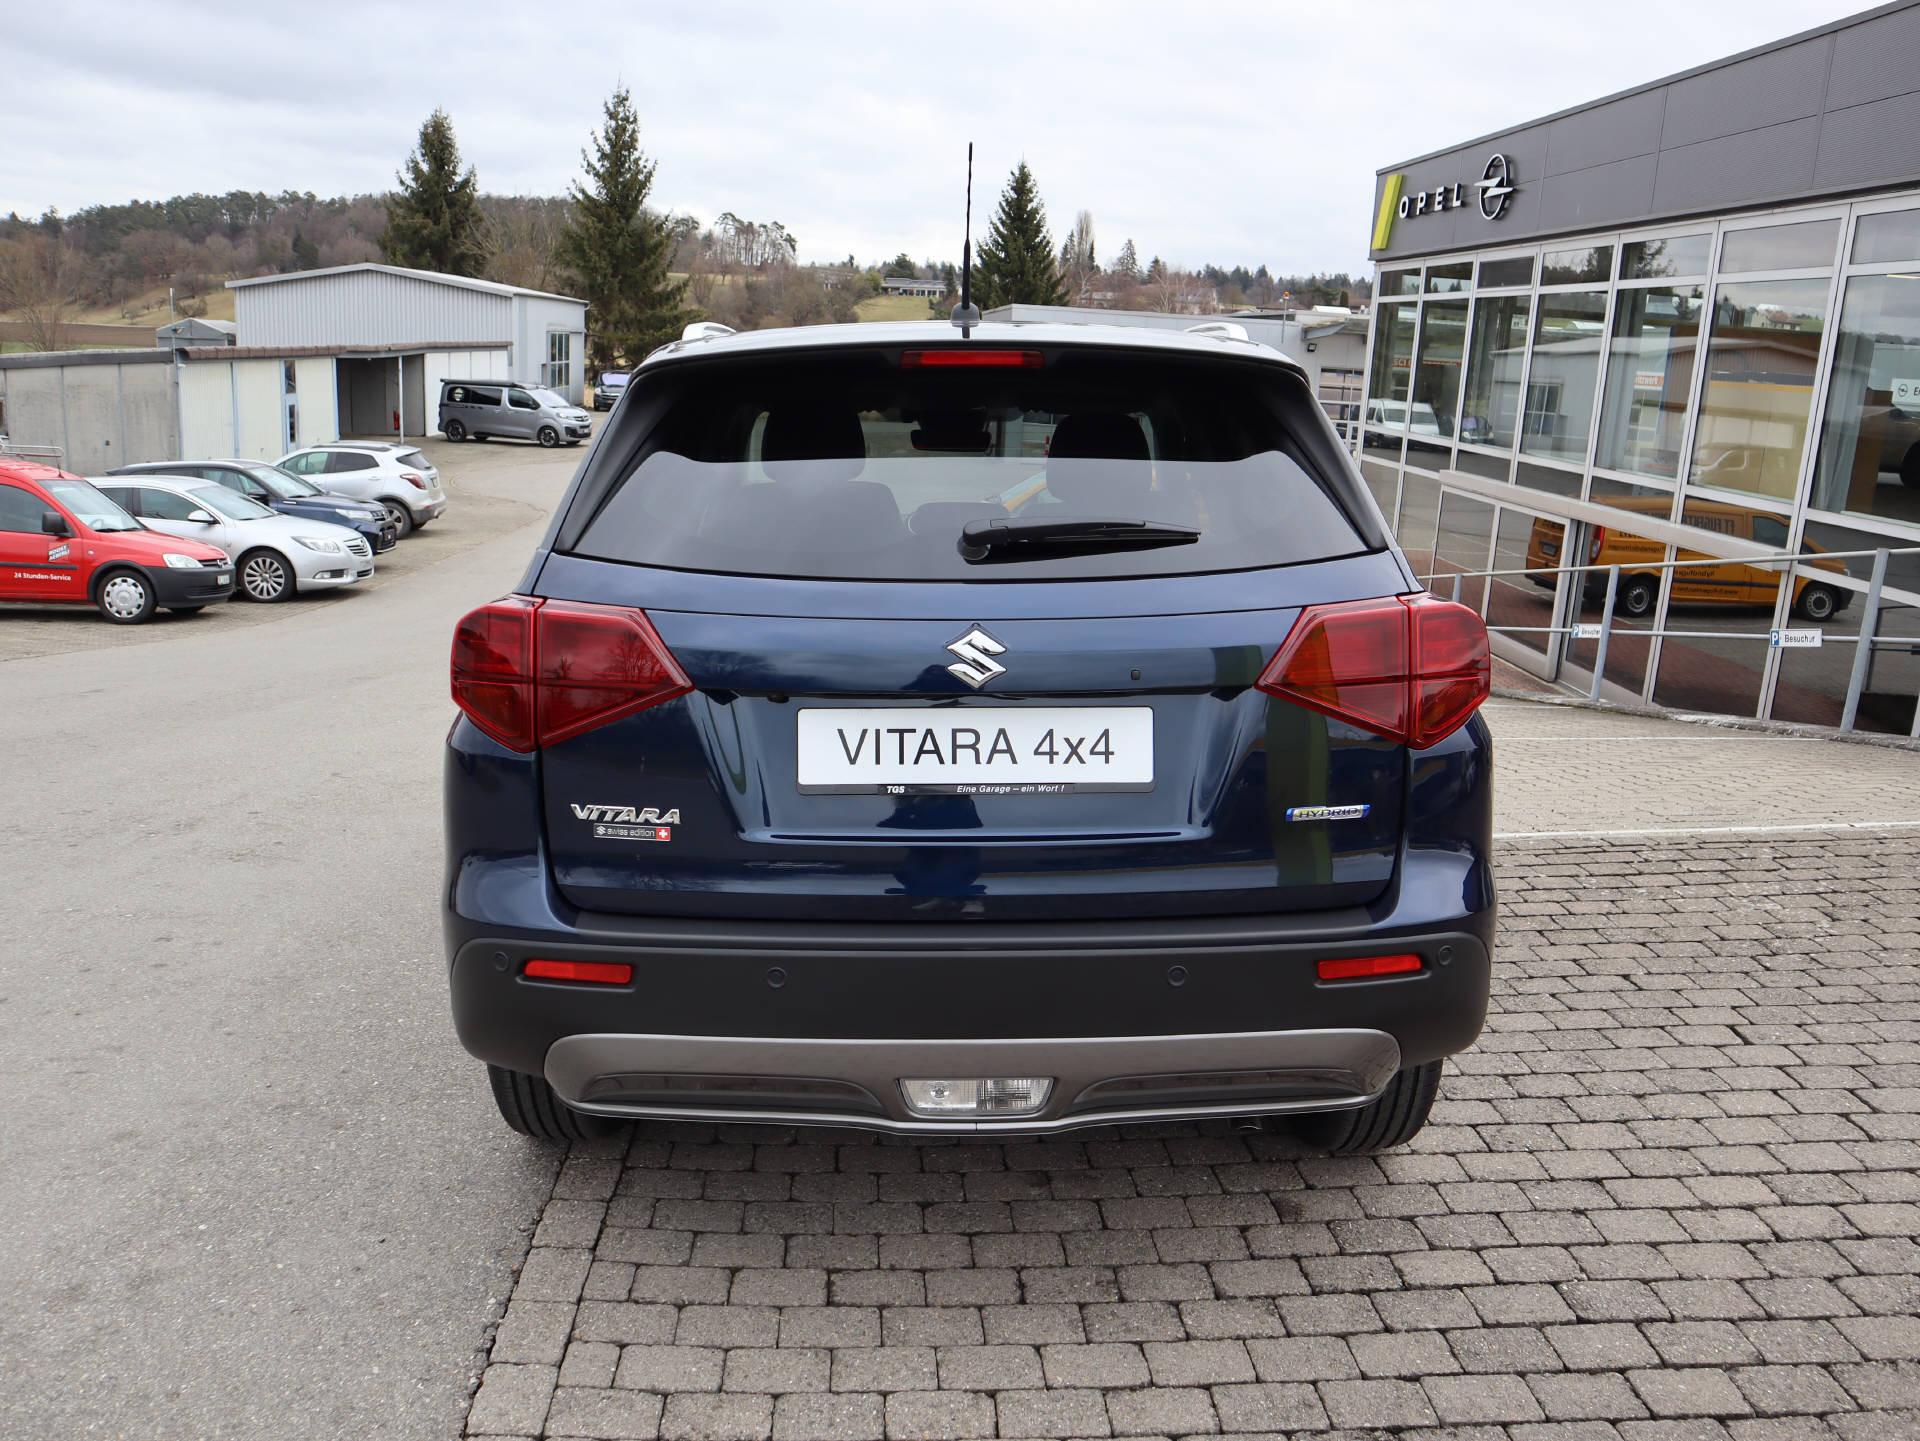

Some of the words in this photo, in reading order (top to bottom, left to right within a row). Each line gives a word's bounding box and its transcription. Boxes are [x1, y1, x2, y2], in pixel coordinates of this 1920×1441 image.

[1399, 183, 1462, 219] OPEL
[836, 728, 1018, 765] VITARA
[1033, 728, 1115, 765] 4x4
[886, 785, 905, 794] TGS
[956, 785, 977, 793] Eine
[979, 785, 1011, 794] Garage
[1021, 785, 1035, 793] ein
[1037, 785, 1059, 793] Wort
[570, 803, 681, 825] VITARA
[1297, 807, 1360, 818] HYBRID
[607, 828, 628, 836] swiss
[630, 828, 655, 837] edition
